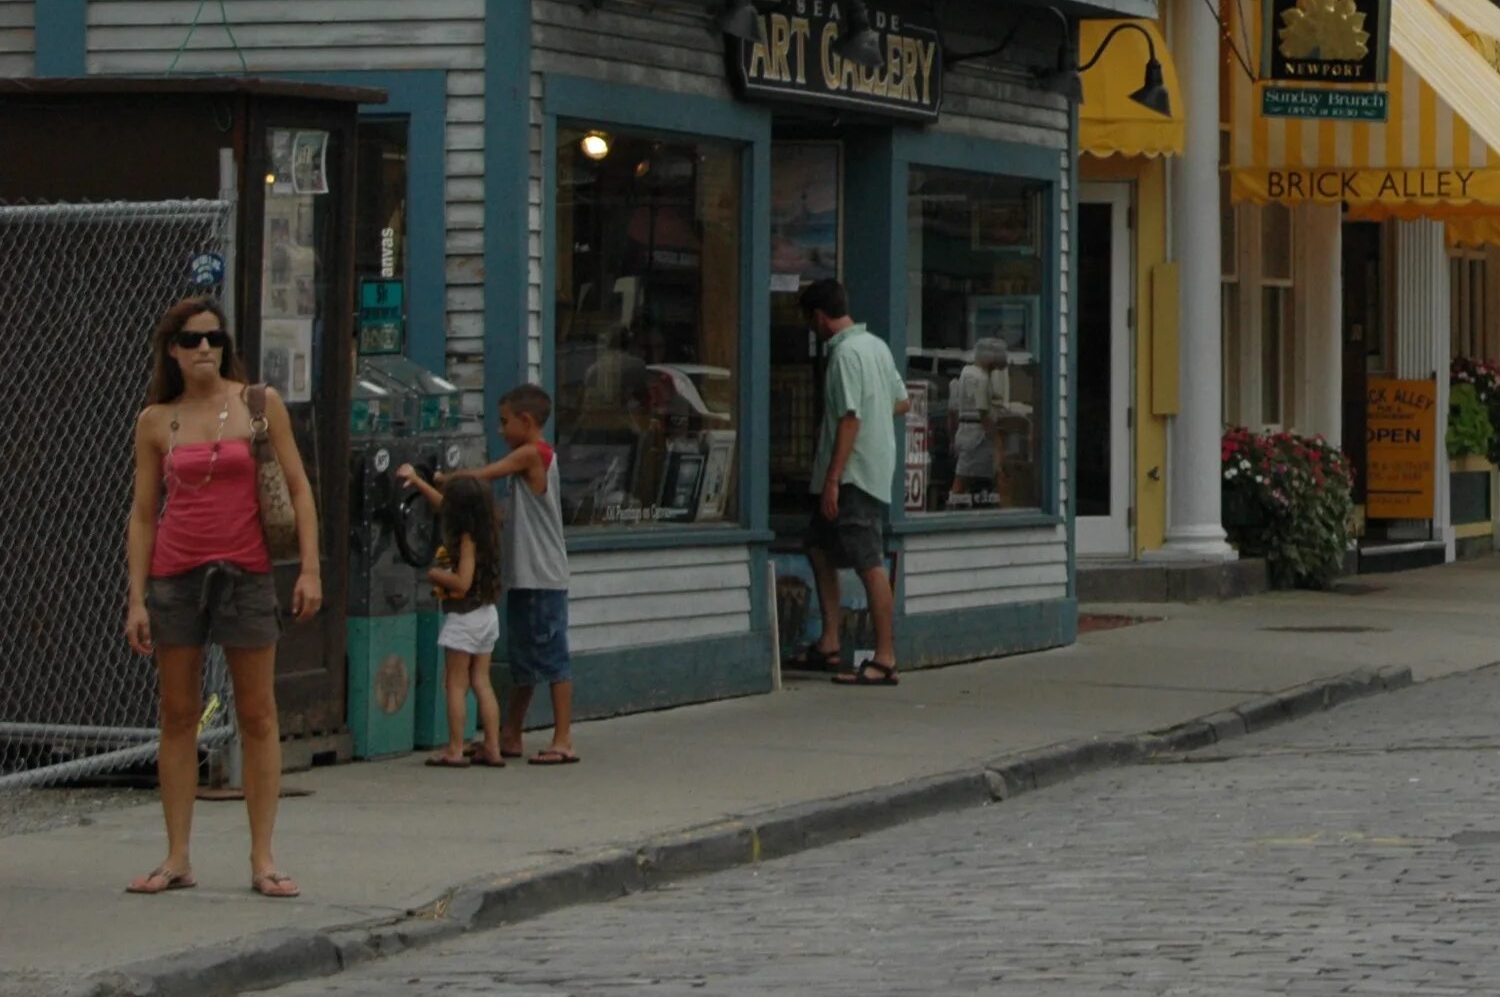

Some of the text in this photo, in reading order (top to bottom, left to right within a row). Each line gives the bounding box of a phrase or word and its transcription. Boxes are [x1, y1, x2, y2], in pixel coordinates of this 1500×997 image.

[749, 13, 811, 85] ART
[1285, 62, 1363, 77] NEWPORT
[1265, 90, 1384, 108] Sunday Brunch
[1267, 169, 1476, 199] BRICK ALLEY
[381, 227, 394, 277] anvas
[1394, 389, 1434, 411] ALLEY
